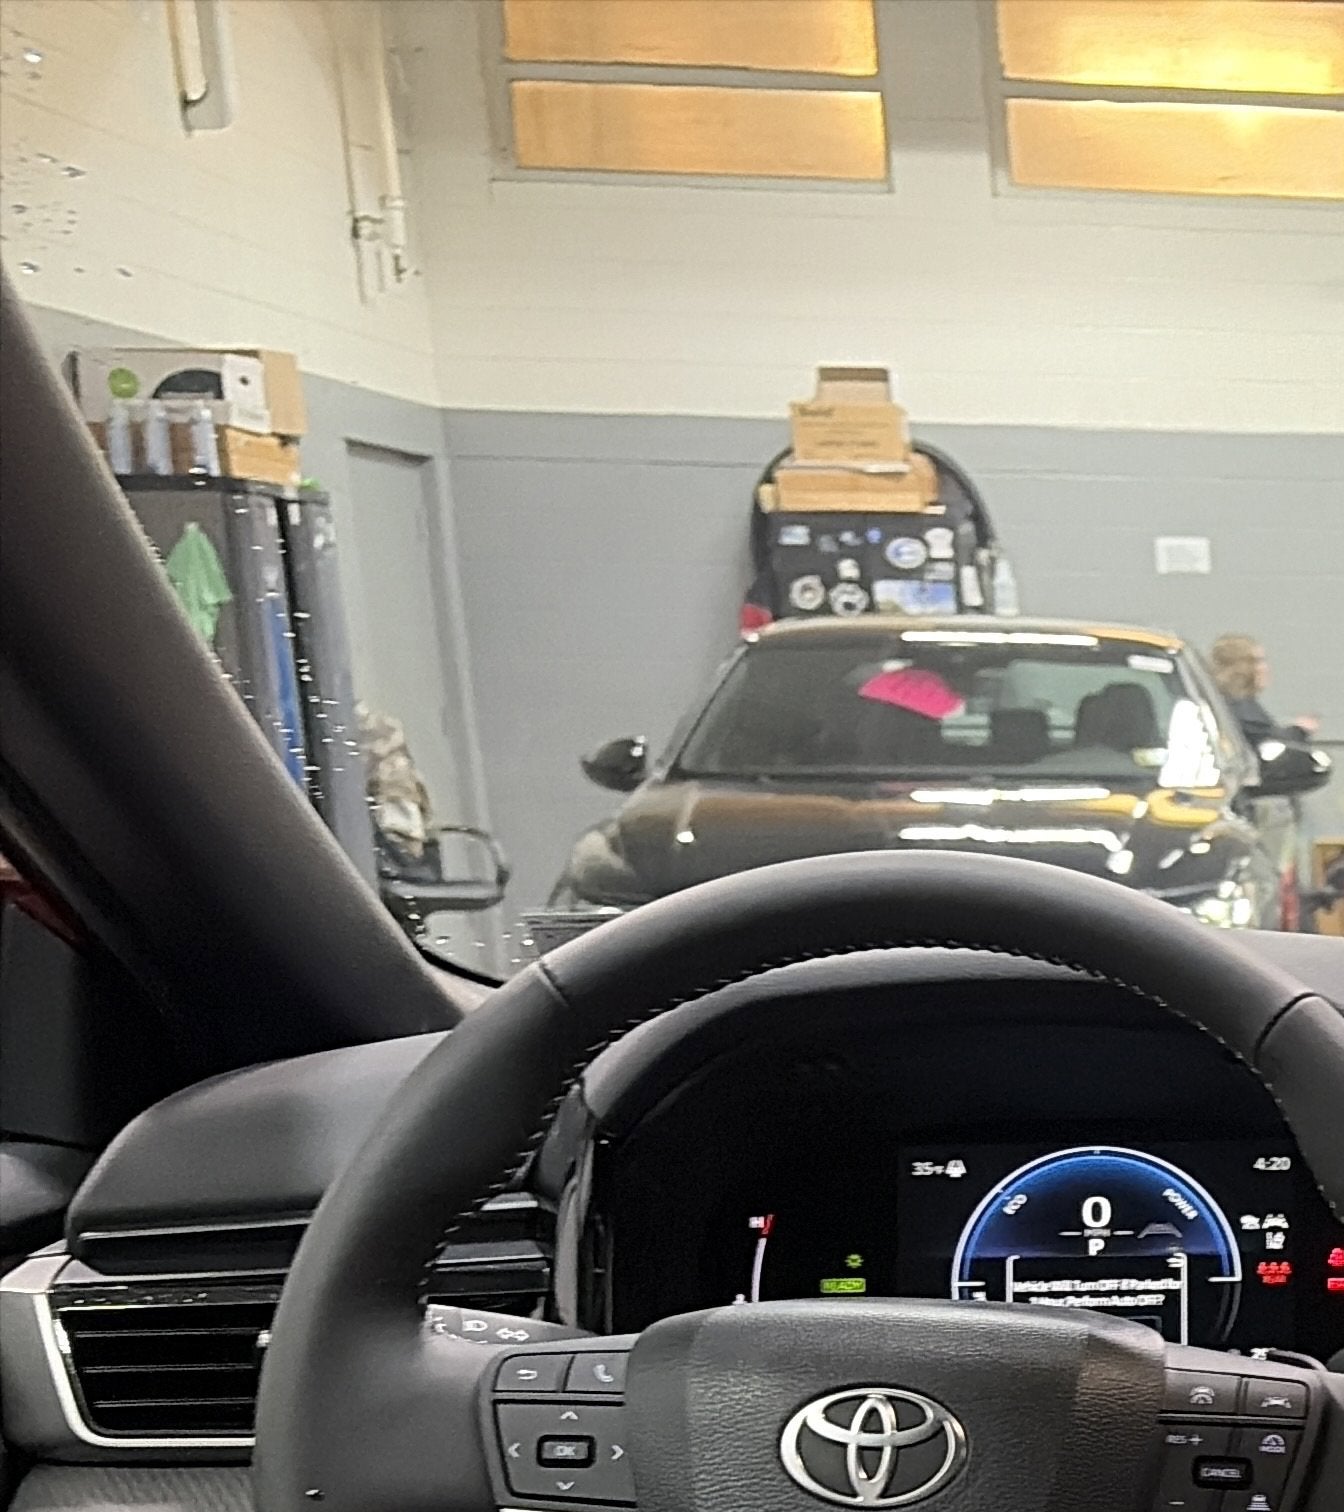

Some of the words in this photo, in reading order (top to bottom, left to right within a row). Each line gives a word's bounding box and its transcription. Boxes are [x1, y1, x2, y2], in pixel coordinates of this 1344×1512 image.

[1253, 1157, 1291, 1171] 4:20
[1081, 1196, 1112, 1228] 0
[1088, 1239, 1105, 1256] P
